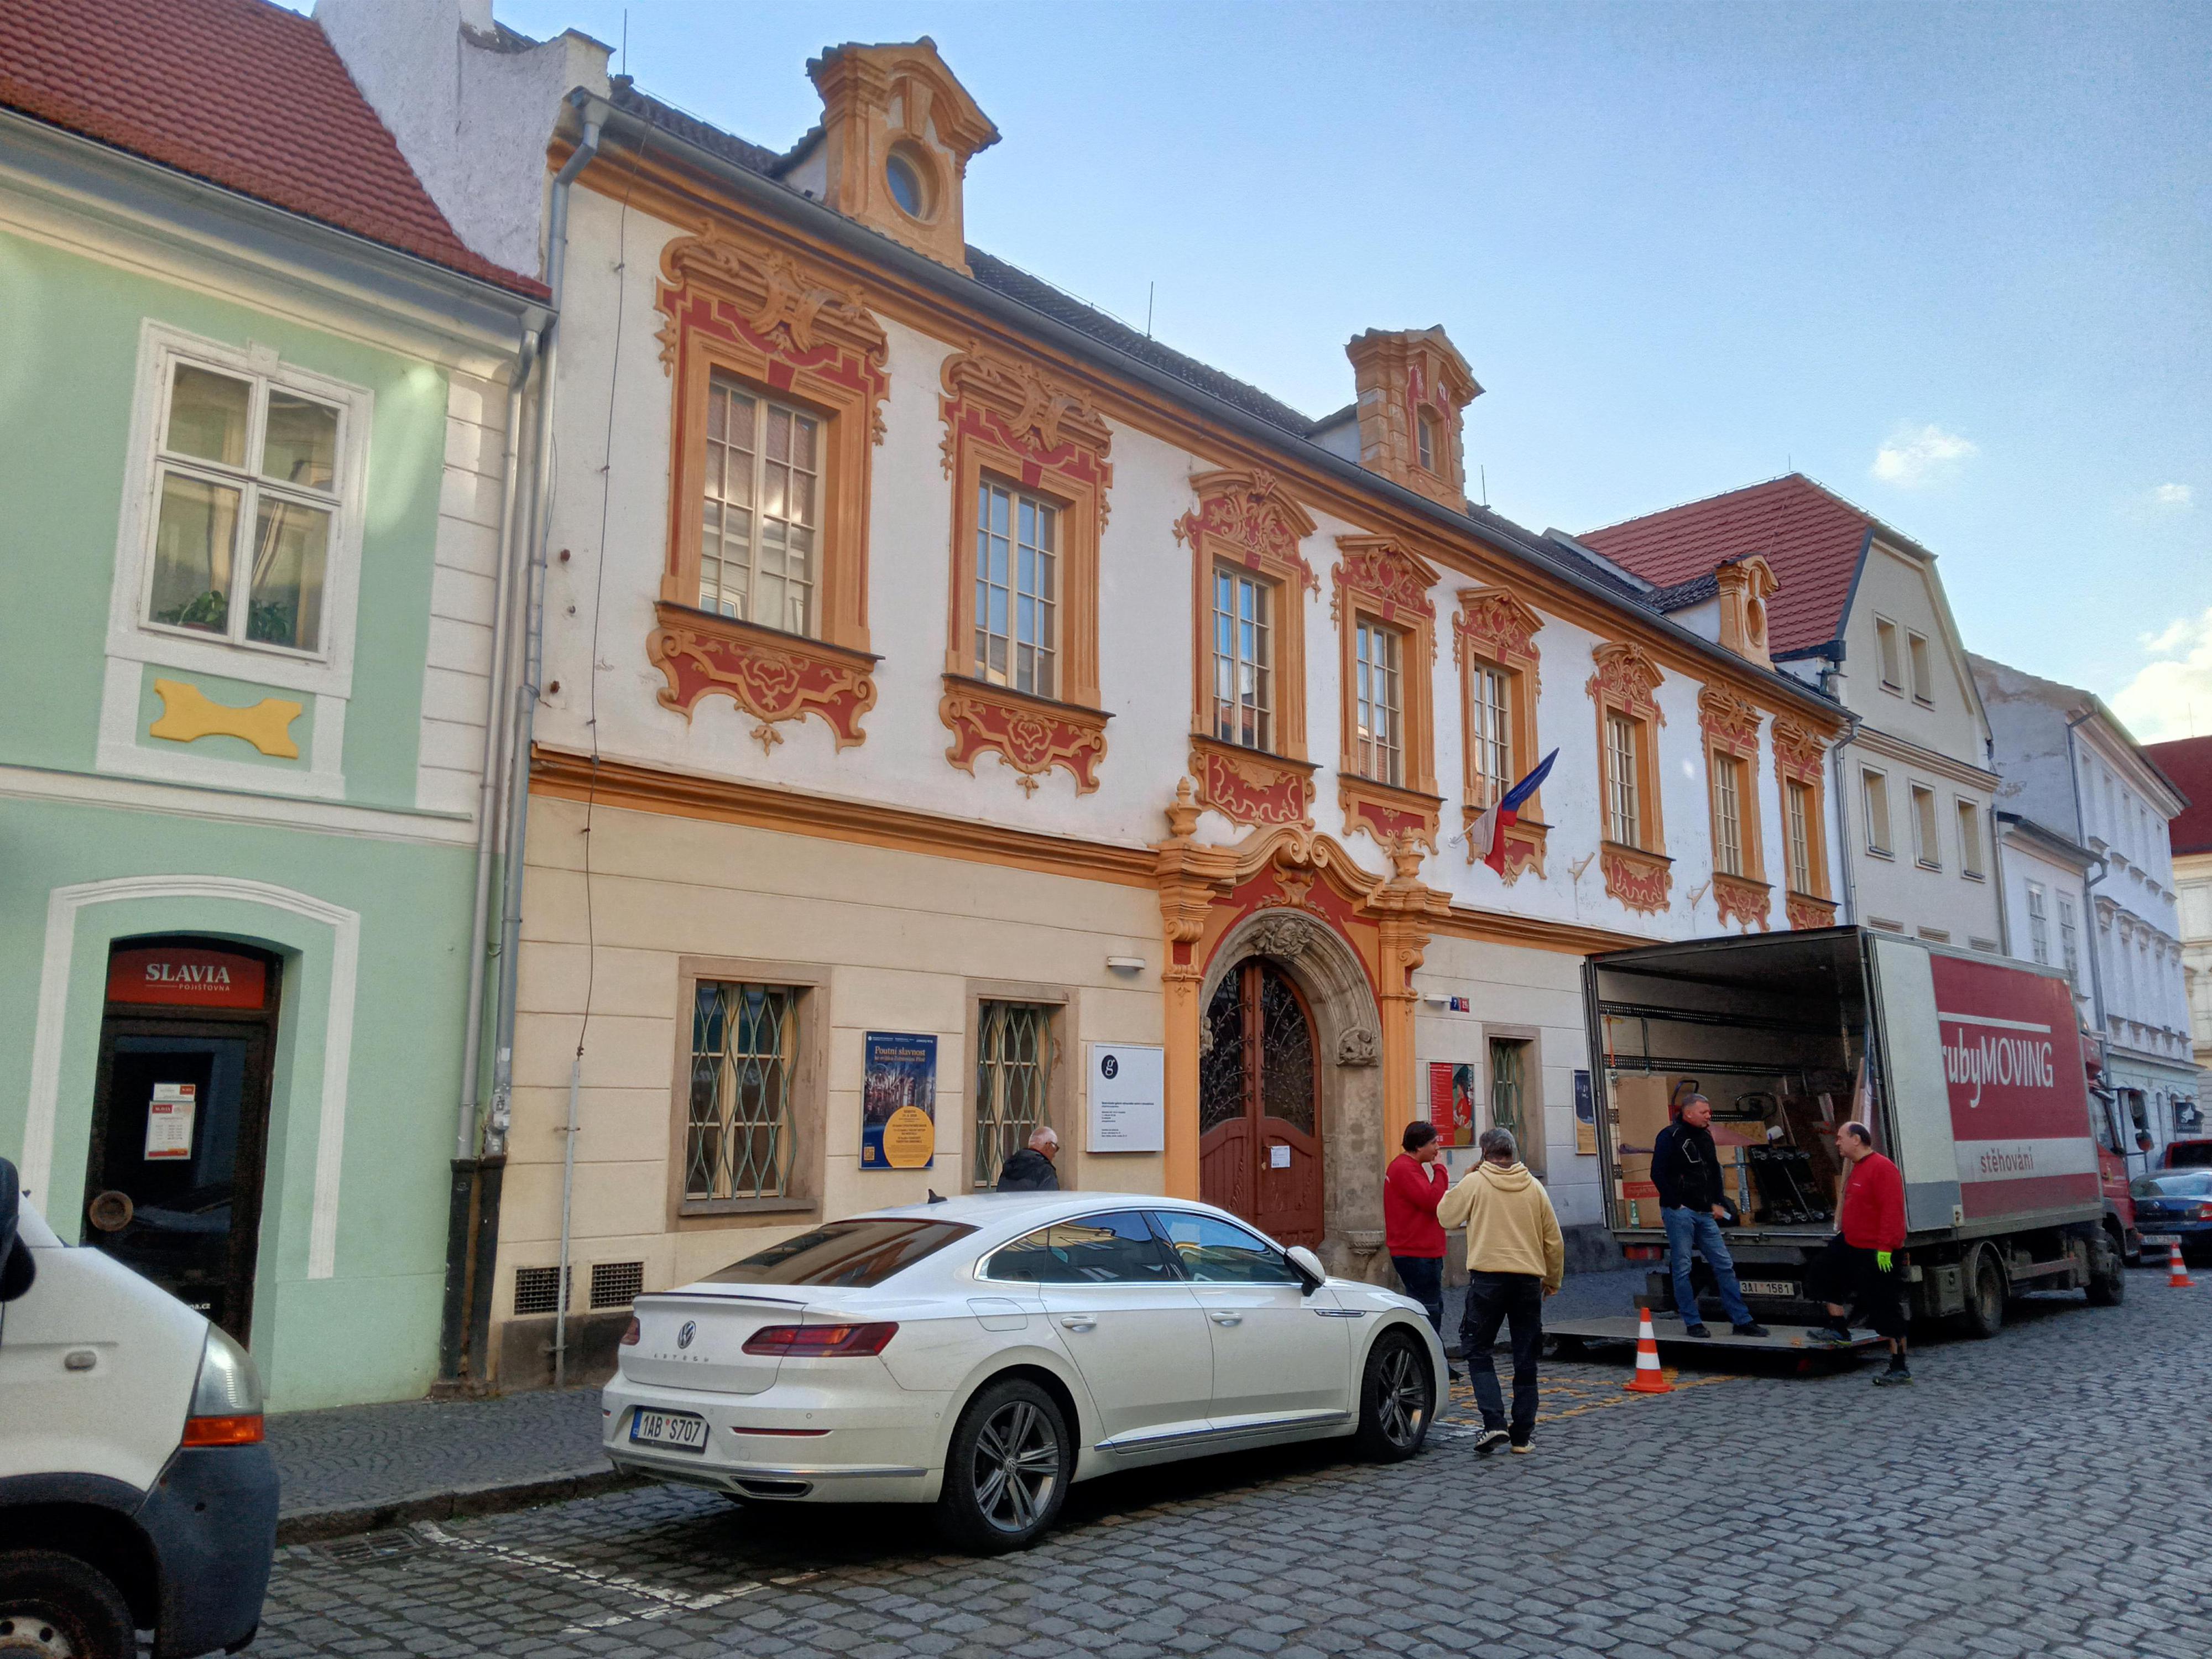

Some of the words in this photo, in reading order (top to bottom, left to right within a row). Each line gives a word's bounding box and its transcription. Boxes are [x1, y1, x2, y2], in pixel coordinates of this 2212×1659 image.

[145, 963, 231, 983] SLAVIA
[1981, 1146, 2034, 1173] stěhování
[644, 1415, 663, 1438] 1AB
[669, 1418, 701, 1443] S707
